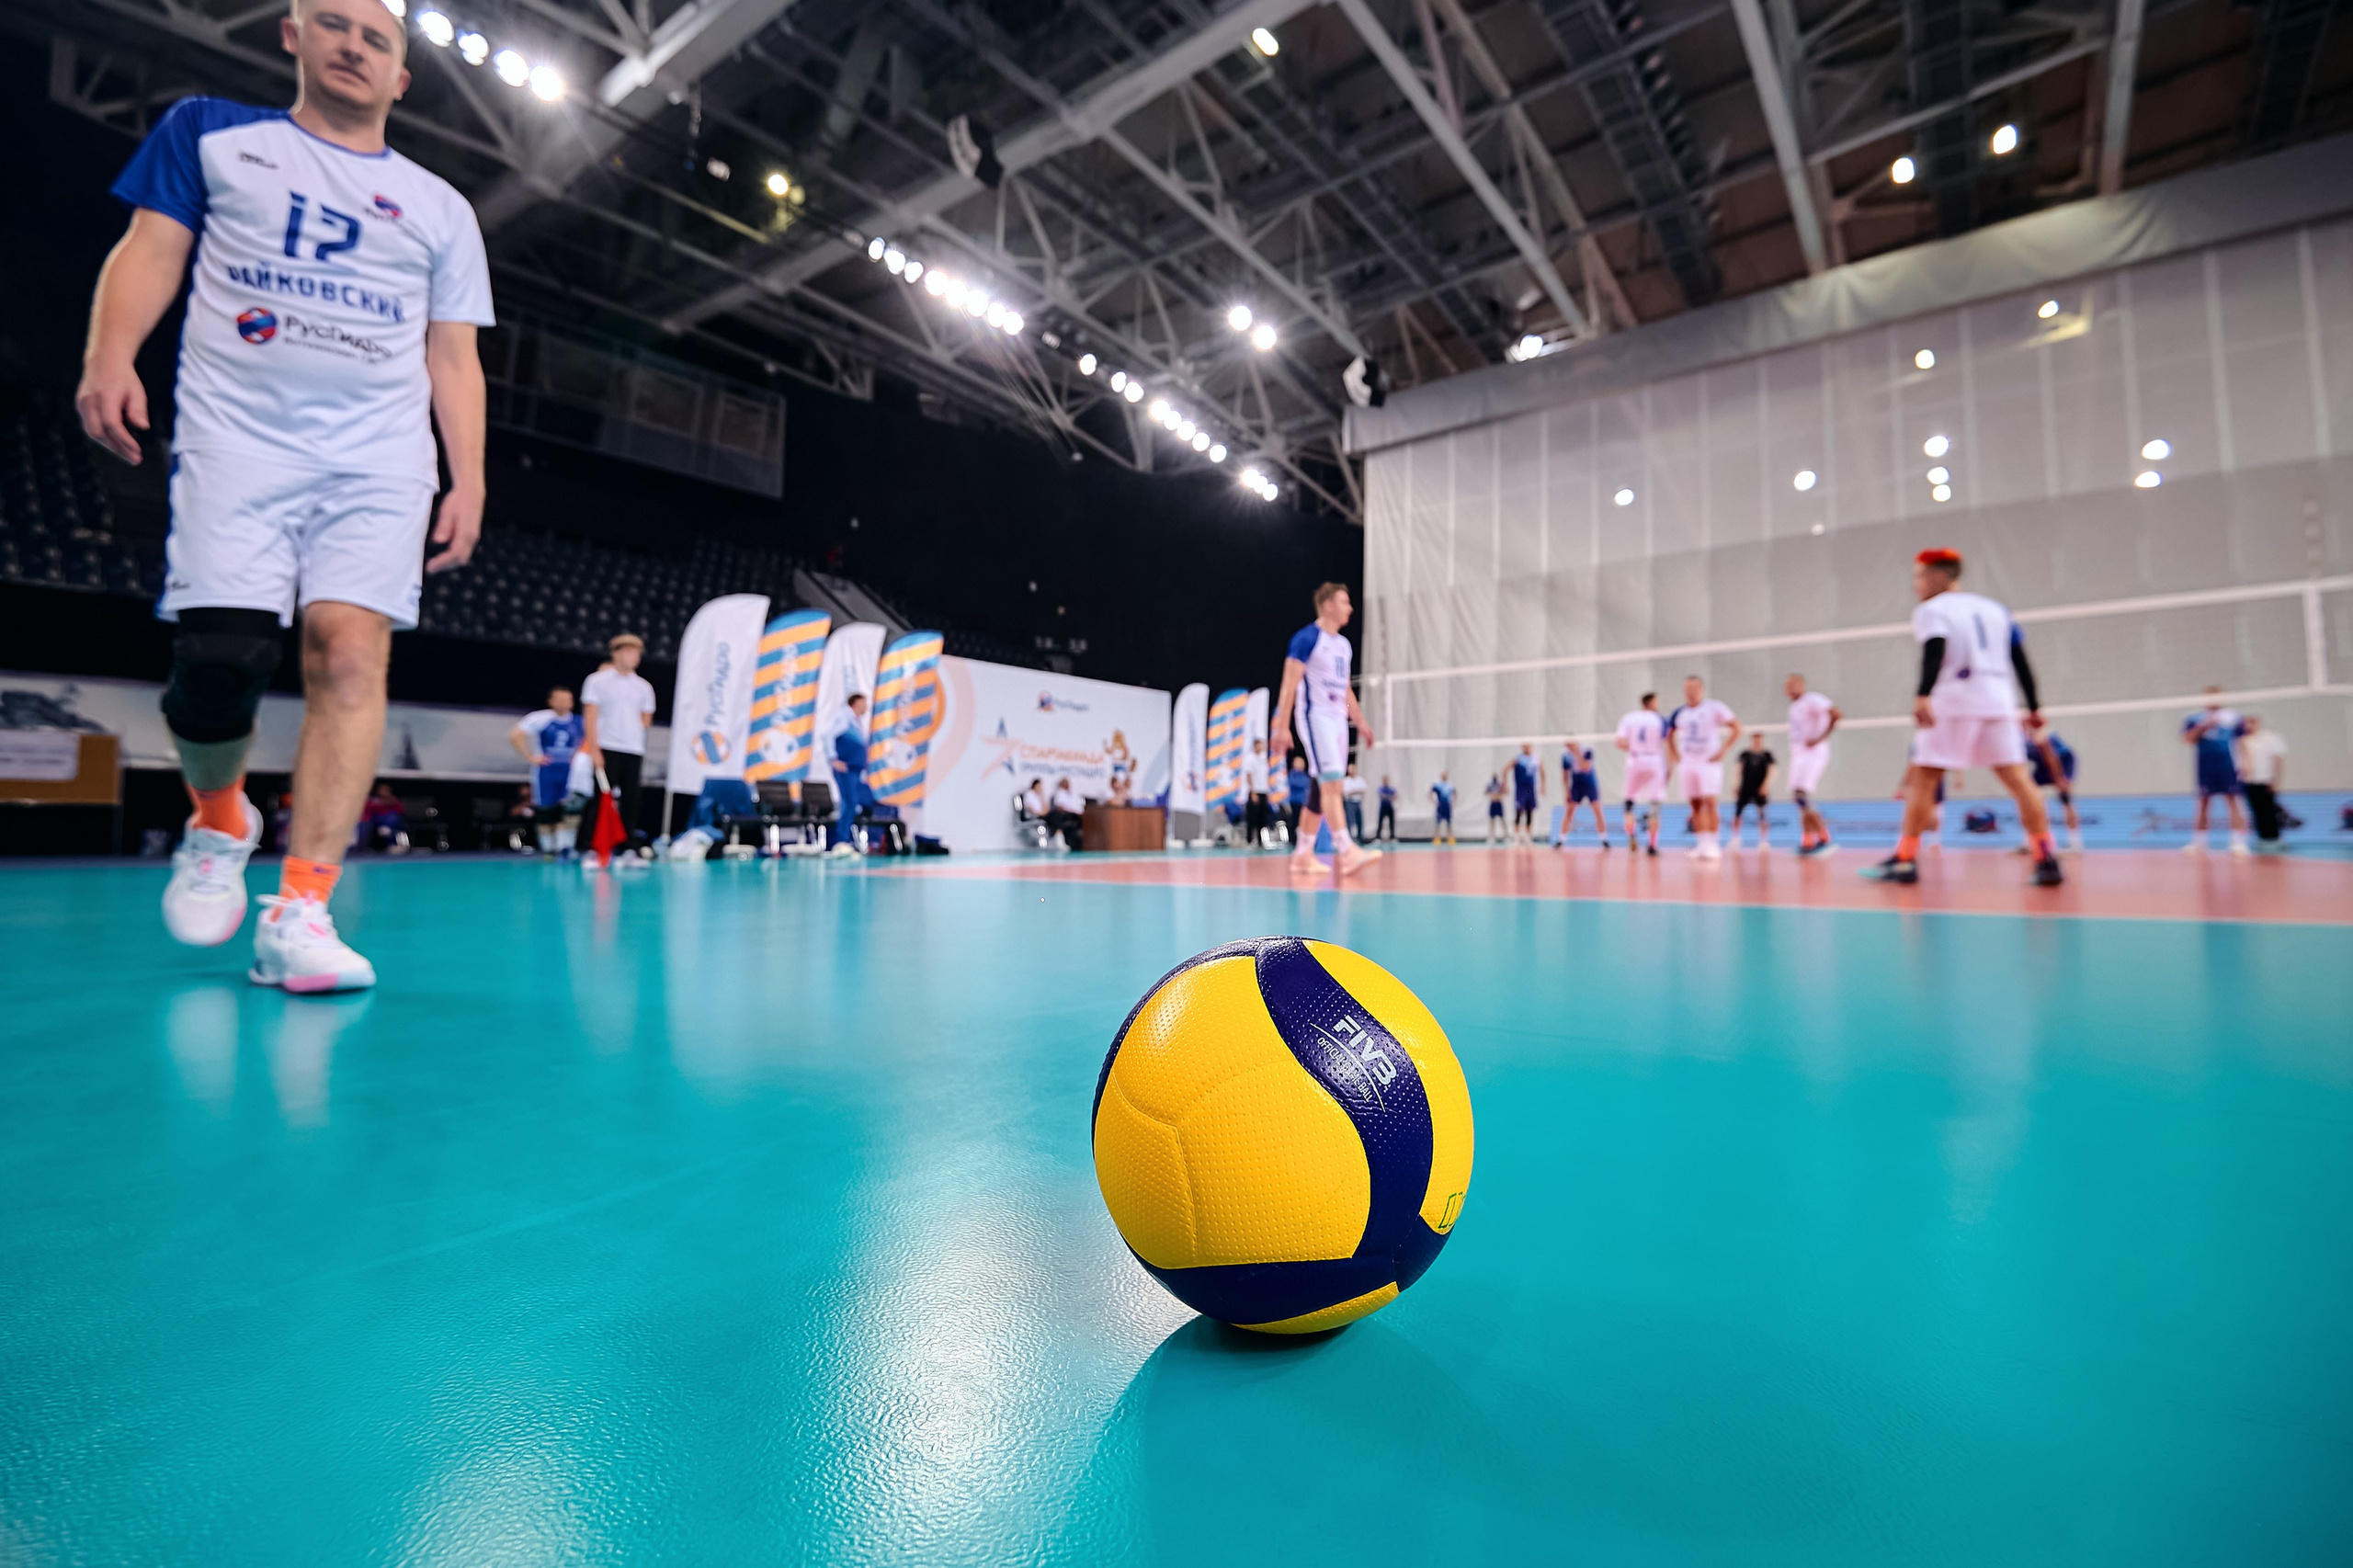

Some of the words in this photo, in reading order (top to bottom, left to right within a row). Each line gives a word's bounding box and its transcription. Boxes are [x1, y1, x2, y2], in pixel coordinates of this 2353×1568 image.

[282, 189, 363, 261] 12
[1316, 1036, 1347, 1064] OFFICIAL
[1358, 1082, 1373, 1103] BALL
[1333, 1014, 1397, 1085] FIVB
